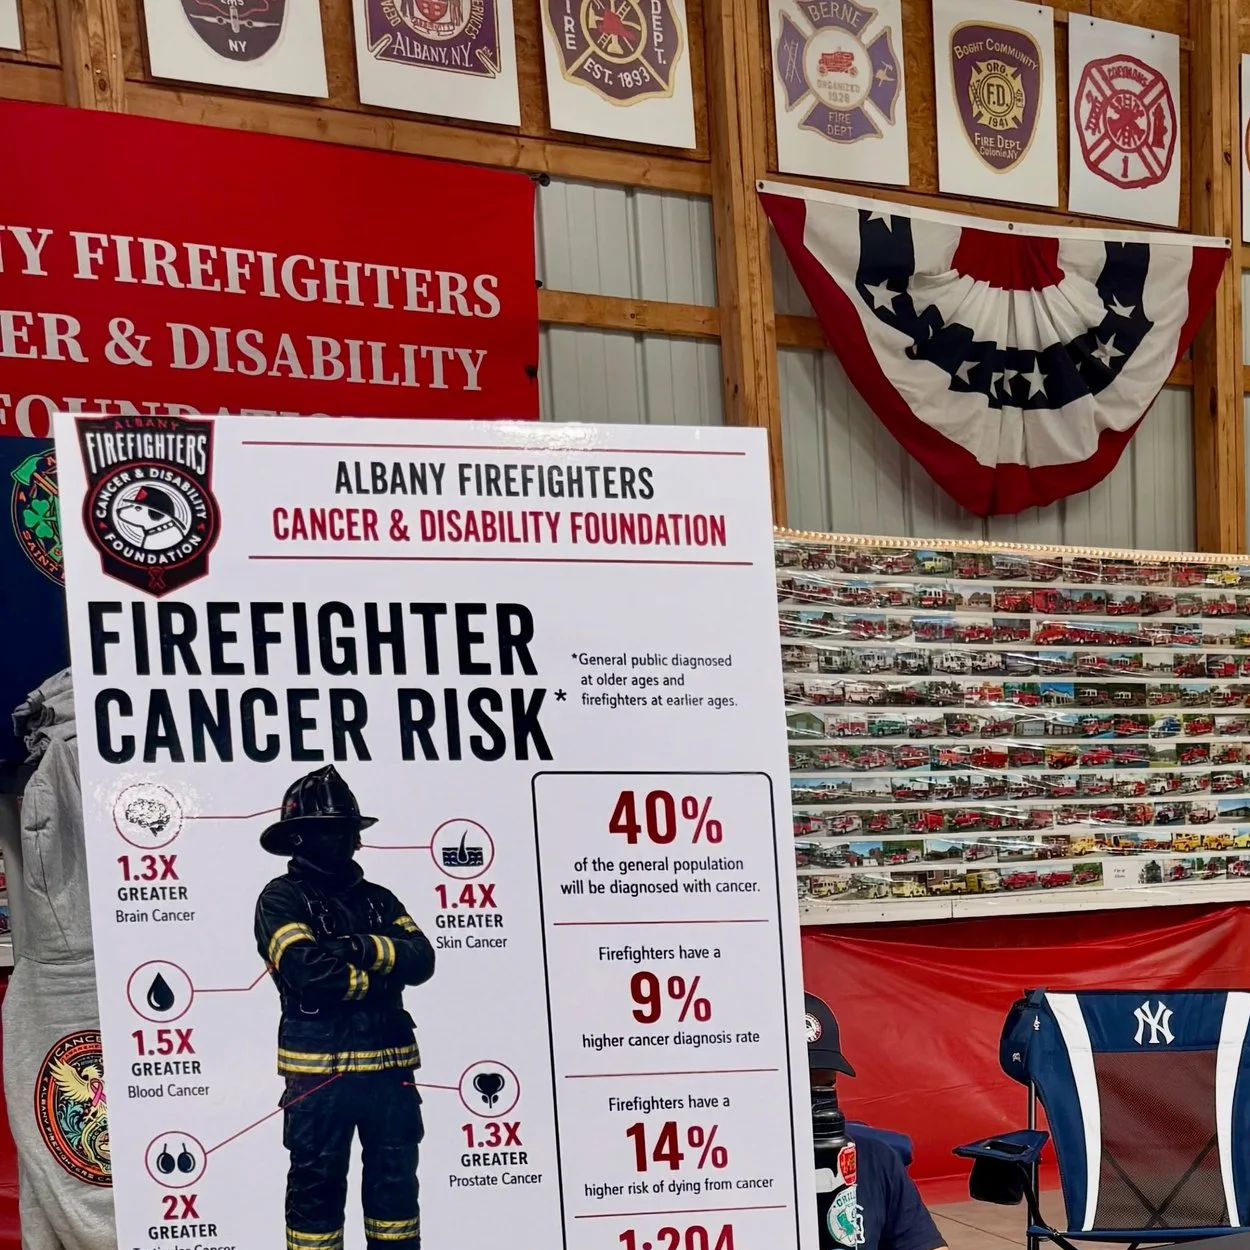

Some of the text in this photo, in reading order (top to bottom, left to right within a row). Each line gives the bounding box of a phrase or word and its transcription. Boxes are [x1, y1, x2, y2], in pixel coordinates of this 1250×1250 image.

[810, 0, 863, 28] BERNE
[229, 39, 246, 52] NY
[583, 59, 650, 88] EST. 1893
[827, 124, 853, 137] DEPT
[829, 112, 851, 124] FIRE
[987, 117, 1009, 128] 1941
[974, 136, 995, 147] FIRE
[74, 230, 501, 319] FIREFIGHTERS
[104, 319, 488, 393] & DISABILITY
[335, 461, 654, 499] ALBANY FIREFIGHTERS
[273, 507, 726, 546] CANCER & DISABILITY FOUNDATION
[88, 601, 538, 676] FIREFIGHTER
[631, 653, 668, 669] public
[671, 653, 732, 669] diagnosed
[95, 688, 372, 764] CANCER
[609, 790, 722, 844] 40%
[117, 855, 179, 881] 1.3X
[574, 856, 743, 875] of the general population
[118, 886, 188, 901] GREATER
[116, 909, 195, 922] Brain Cancer
[631, 971, 711, 1024] 9%
[626, 1121, 728, 1172] 14%
[162, 1194, 199, 1220] 2X
[148, 1224, 217, 1240] GREATER
